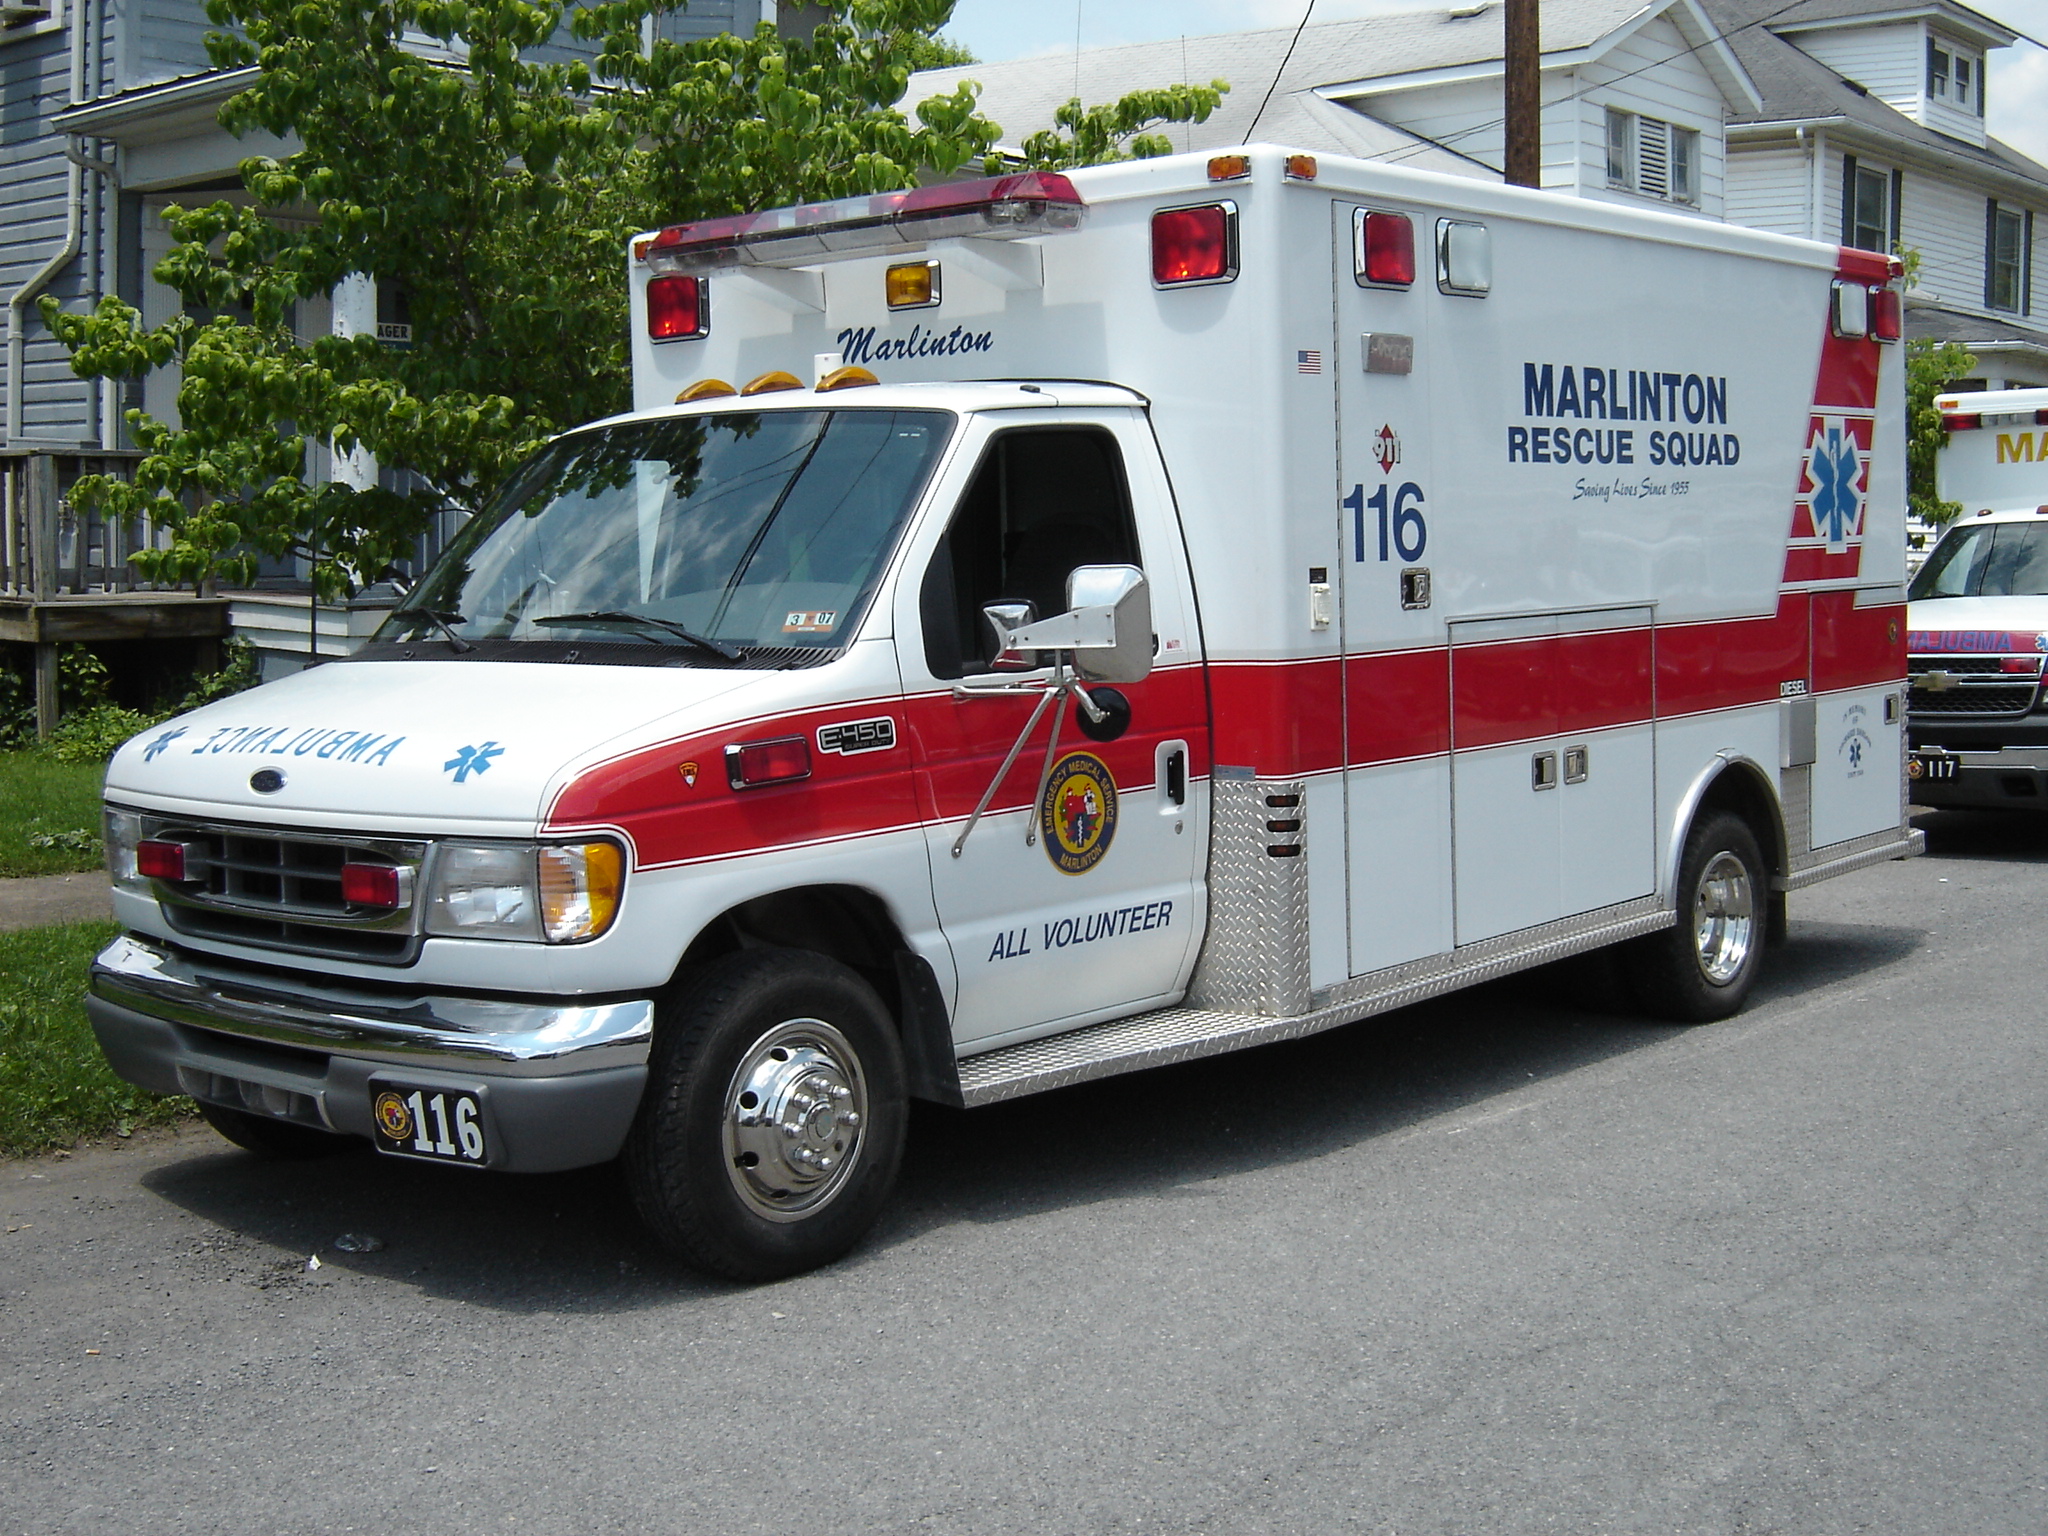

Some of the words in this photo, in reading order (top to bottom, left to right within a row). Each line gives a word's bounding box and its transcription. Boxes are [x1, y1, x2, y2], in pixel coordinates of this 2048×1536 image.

[838, 324, 994, 364] Marlinton
[1524, 362, 1727, 424] MARLINTON
[1372, 438, 1401, 463] 911
[1508, 426, 1634, 464] RESCUE
[1650, 431, 1740, 467] SQUAD
[1573, 478, 1610, 503] Saving
[1613, 478, 1637, 496] Lives
[1639, 477, 1667, 498] Since
[1671, 481, 1690, 495] 1955
[1343, 482, 1427, 562] 116
[791, 615, 800, 626] 3
[818, 612, 834, 624] 07
[1781, 680, 1806, 696] DIESEL
[1929, 761, 1955, 777] 117
[1045, 766, 1067, 834] EMERGENCY
[1068, 761, 1100, 780] MEDICAL
[1100, 777, 1114, 823] SERVICE
[1060, 843, 1102, 869] MARLINTON
[988, 928, 1031, 962] ALL
[1044, 901, 1173, 950] VOLUNTEER
[408, 1091, 484, 1159] 116
